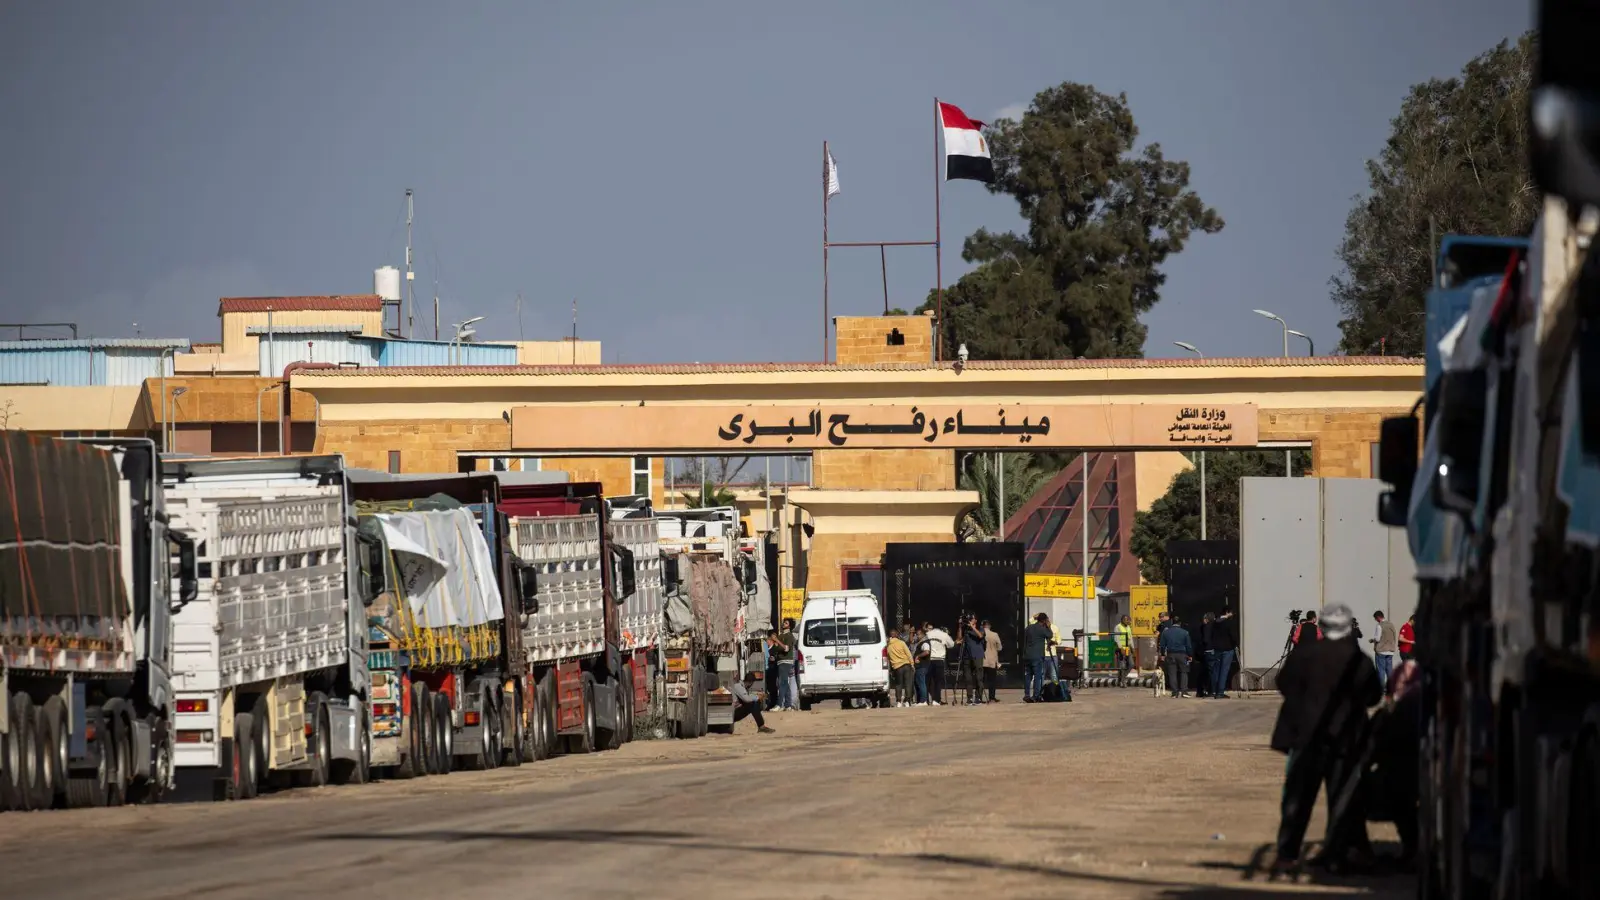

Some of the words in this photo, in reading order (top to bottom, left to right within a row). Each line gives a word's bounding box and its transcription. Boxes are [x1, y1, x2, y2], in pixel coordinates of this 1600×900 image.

[828, 406, 938, 446] رفح
[943, 407, 1051, 443] ميناء
[1176, 407, 1199, 421] النقل
[1201, 407, 1226, 421] وزارة
